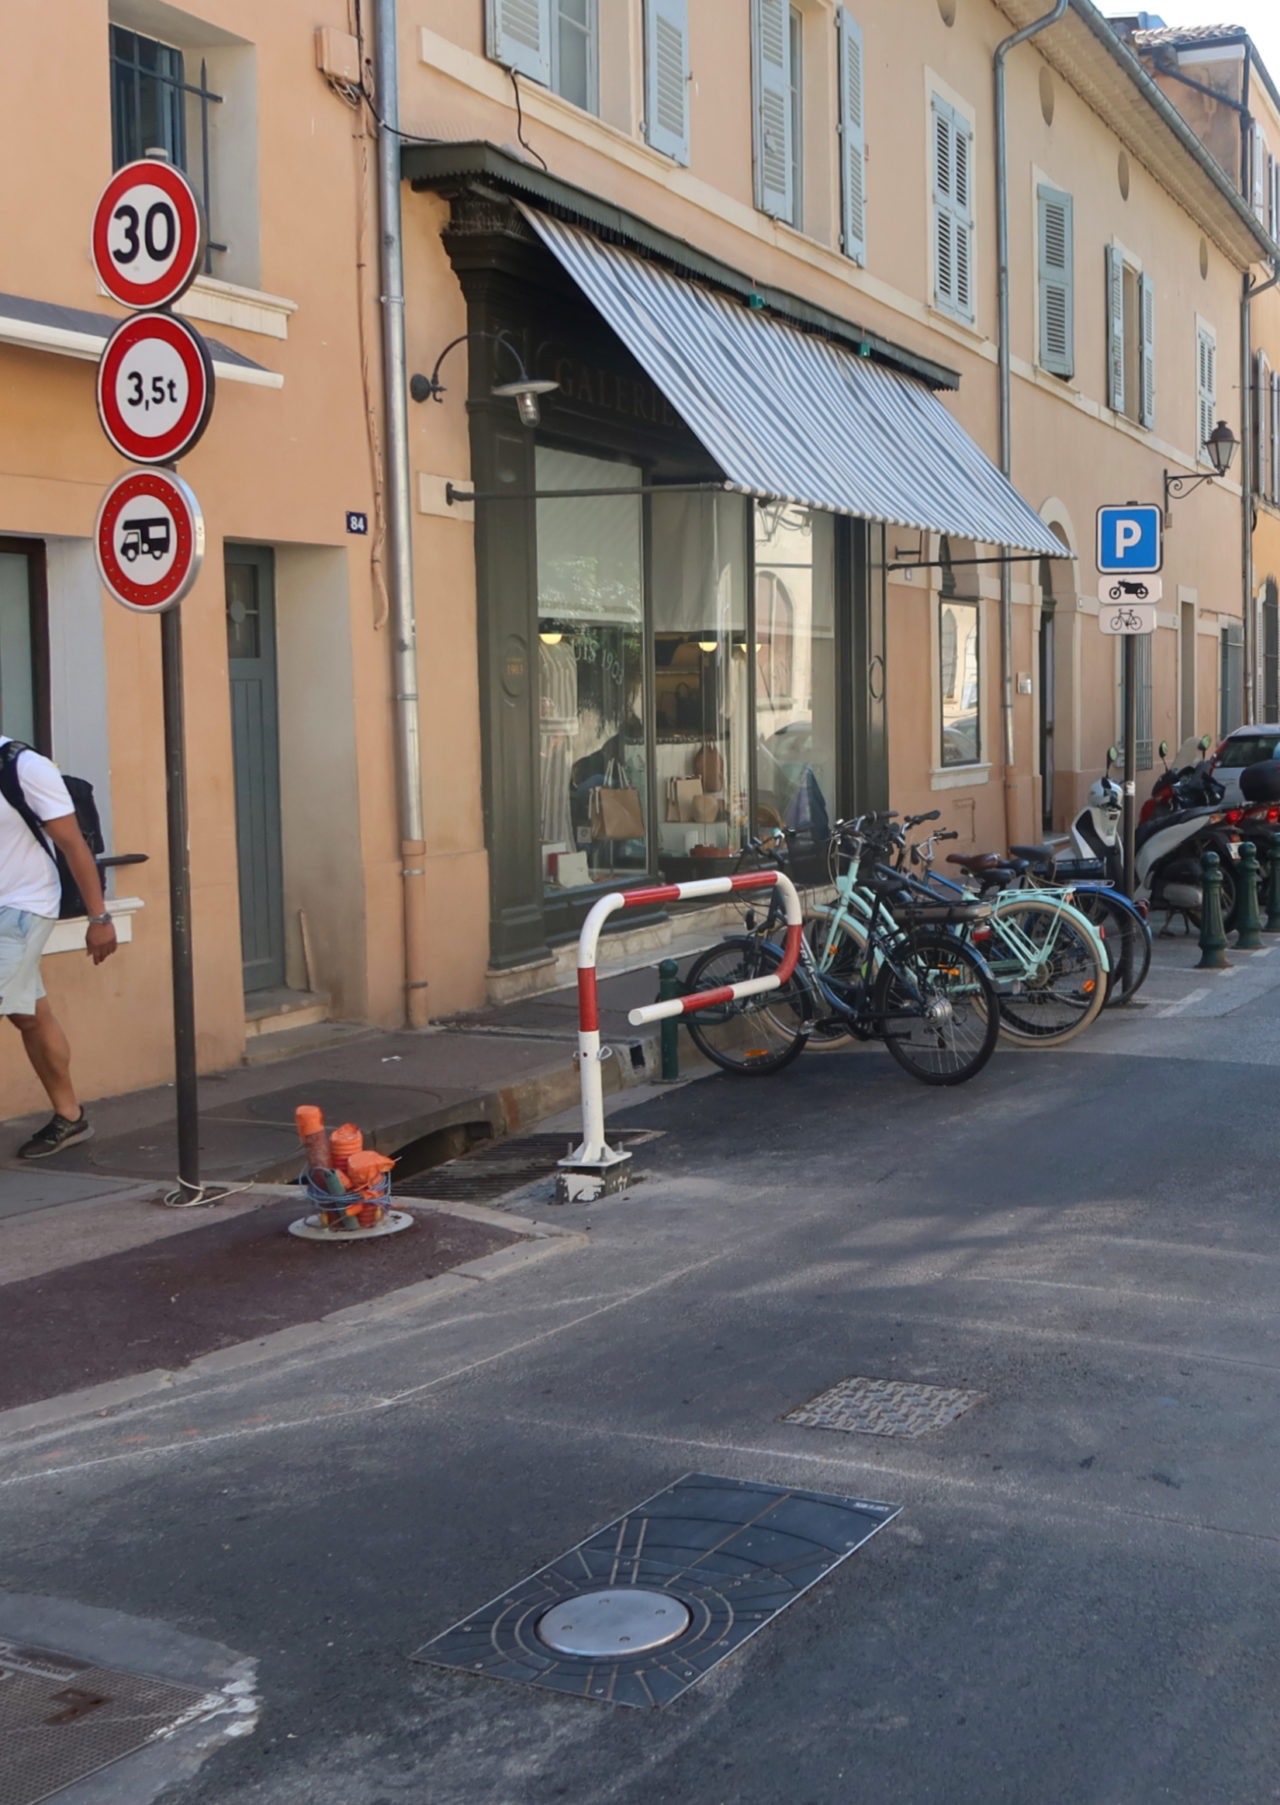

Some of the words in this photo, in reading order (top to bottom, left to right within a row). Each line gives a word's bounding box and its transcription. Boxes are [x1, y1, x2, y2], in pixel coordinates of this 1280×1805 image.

[113, 202, 175, 264] 30
[127, 371, 177, 411] 3,5t
[555, 357, 686, 429] GALERIE
[350, 515, 364, 531] 84
[1116, 520, 1142, 558] P
